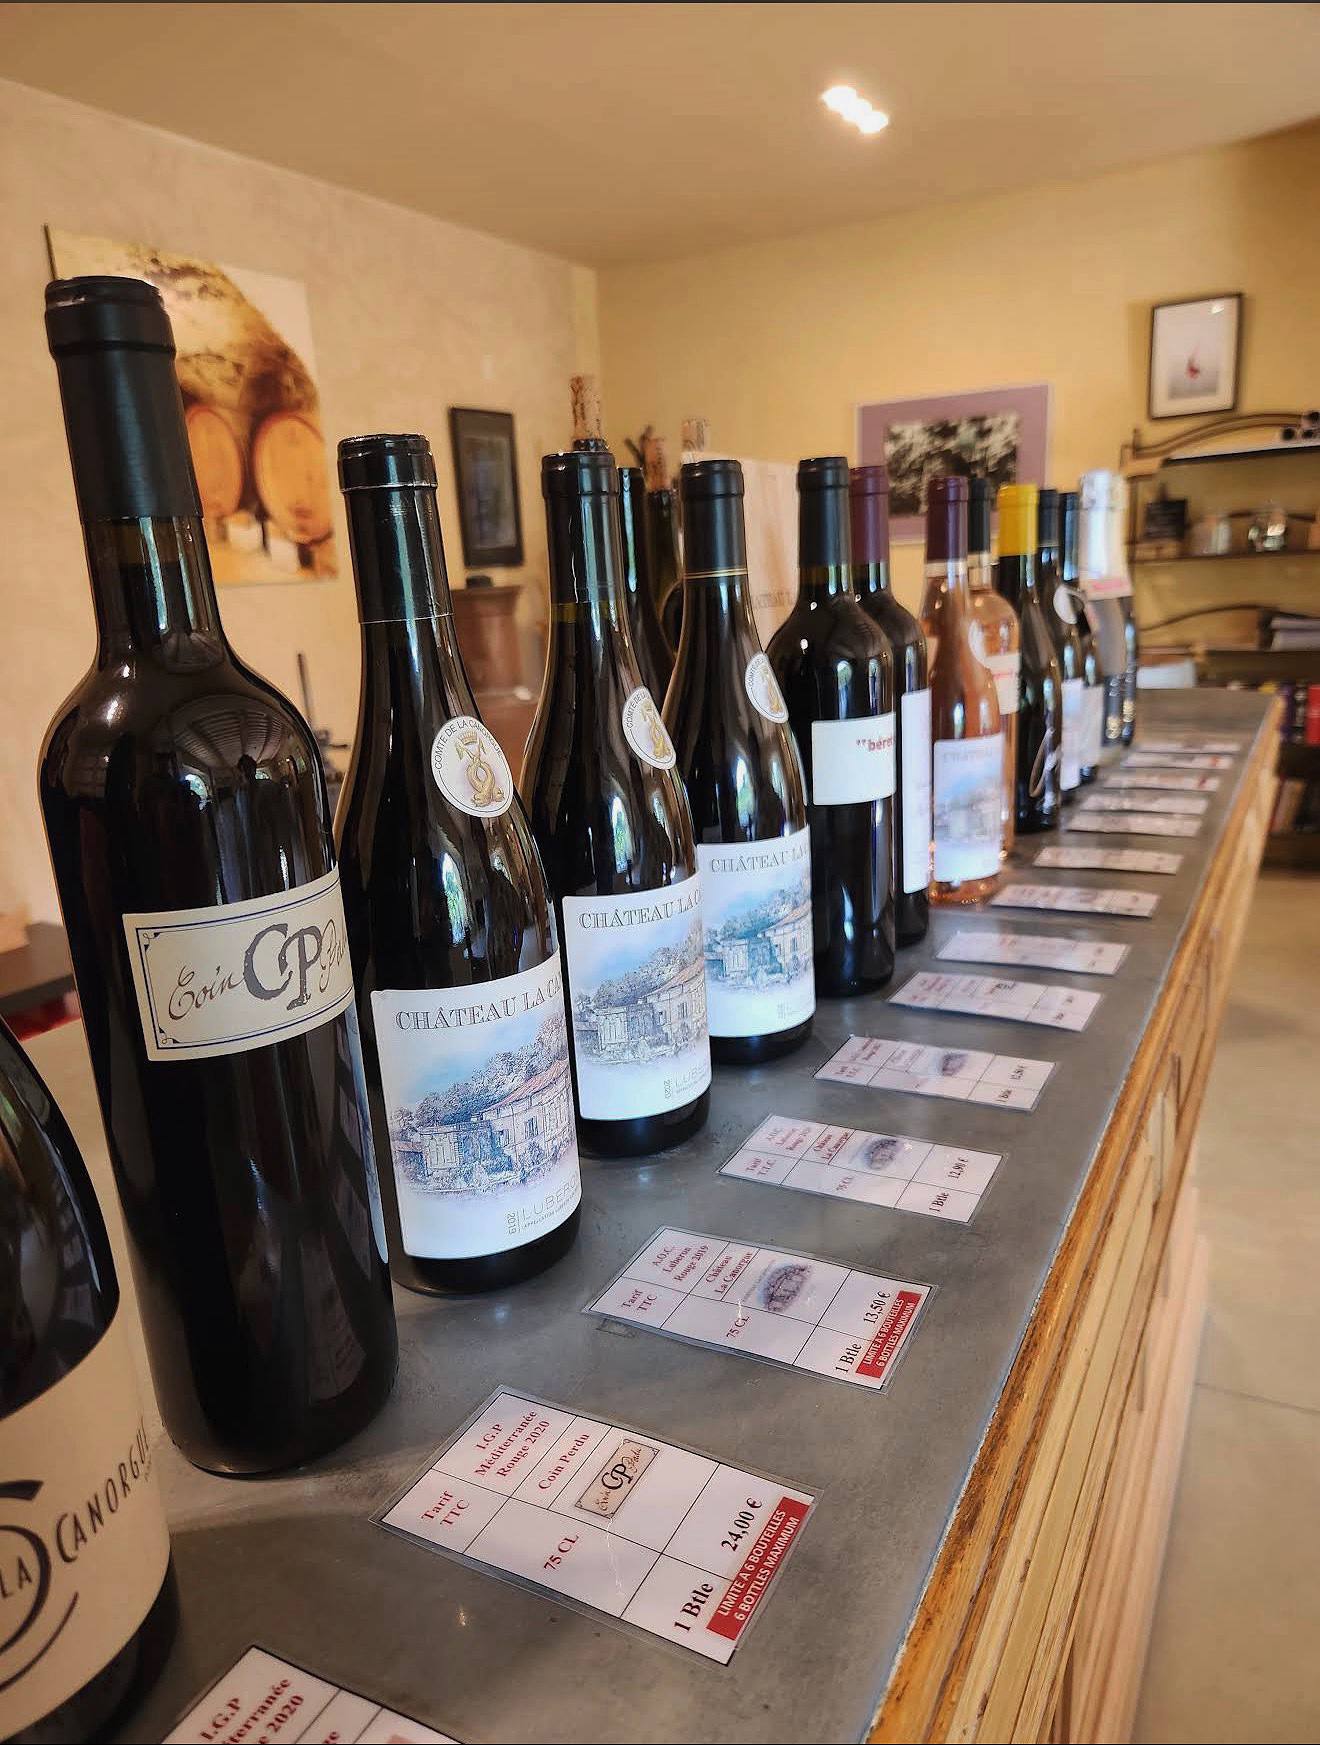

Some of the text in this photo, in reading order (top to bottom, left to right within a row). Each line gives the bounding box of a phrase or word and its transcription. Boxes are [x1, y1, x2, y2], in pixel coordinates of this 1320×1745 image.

[434, 735, 449, 770] COMTE
[444, 724, 457, 737] DE
[457, 719, 468, 729] LA
[578, 902, 674, 929] CHÂTEAU
[677, 893, 694, 914] LA
[395, 996, 518, 1031] CHÂTEAU
[522, 987, 545, 1011] LA
[663, 1246, 692, 1273] Luberon
[674, 1244, 709, 1282] Rouge 2019
[706, 1255, 732, 1283] Château
[621, 1289, 643, 1310] Tarif
[638, 1294, 657, 1313] TTC
[714, 1284, 726, 1294] La
[864, 1290, 891, 1324] 13,50 €
[726, 1316, 750, 1339] 75 CL
[863, 1342, 882, 1366] LIMITE
[880, 1298, 904, 1333] BOUTEILLES
[879, 1334, 899, 1361] BOTTLES
[893, 1301, 916, 1336] MAXIMUM
[840, 1343, 862, 1366] Btle
[474, 1411, 538, 1477] Méditerranée
[475, 1423, 503, 1450] I.G.P
[496, 1420, 550, 1477] Rouge 2020
[538, 1433, 590, 1491] Coin Perdu
[421, 1490, 454, 1520] Tarif
[440, 1499, 470, 1528] TTC
[721, 1497, 763, 1552] 24,00 €
[749, 1508, 787, 1564] BOUTEILLES
[543, 1533, 581, 1572] 75 CL
[733, 1515, 800, 1621] 6 BOTTLES MAXIMUM
[744, 1562, 755, 1571] 6
[673, 1583, 714, 1633] 1 Btle
[718, 1580, 746, 1617] LIMITE
[200, 1697, 241, 1740] I.G.P
[222, 1678, 292, 1743] terranée
[266, 1694, 305, 1734] 2020
